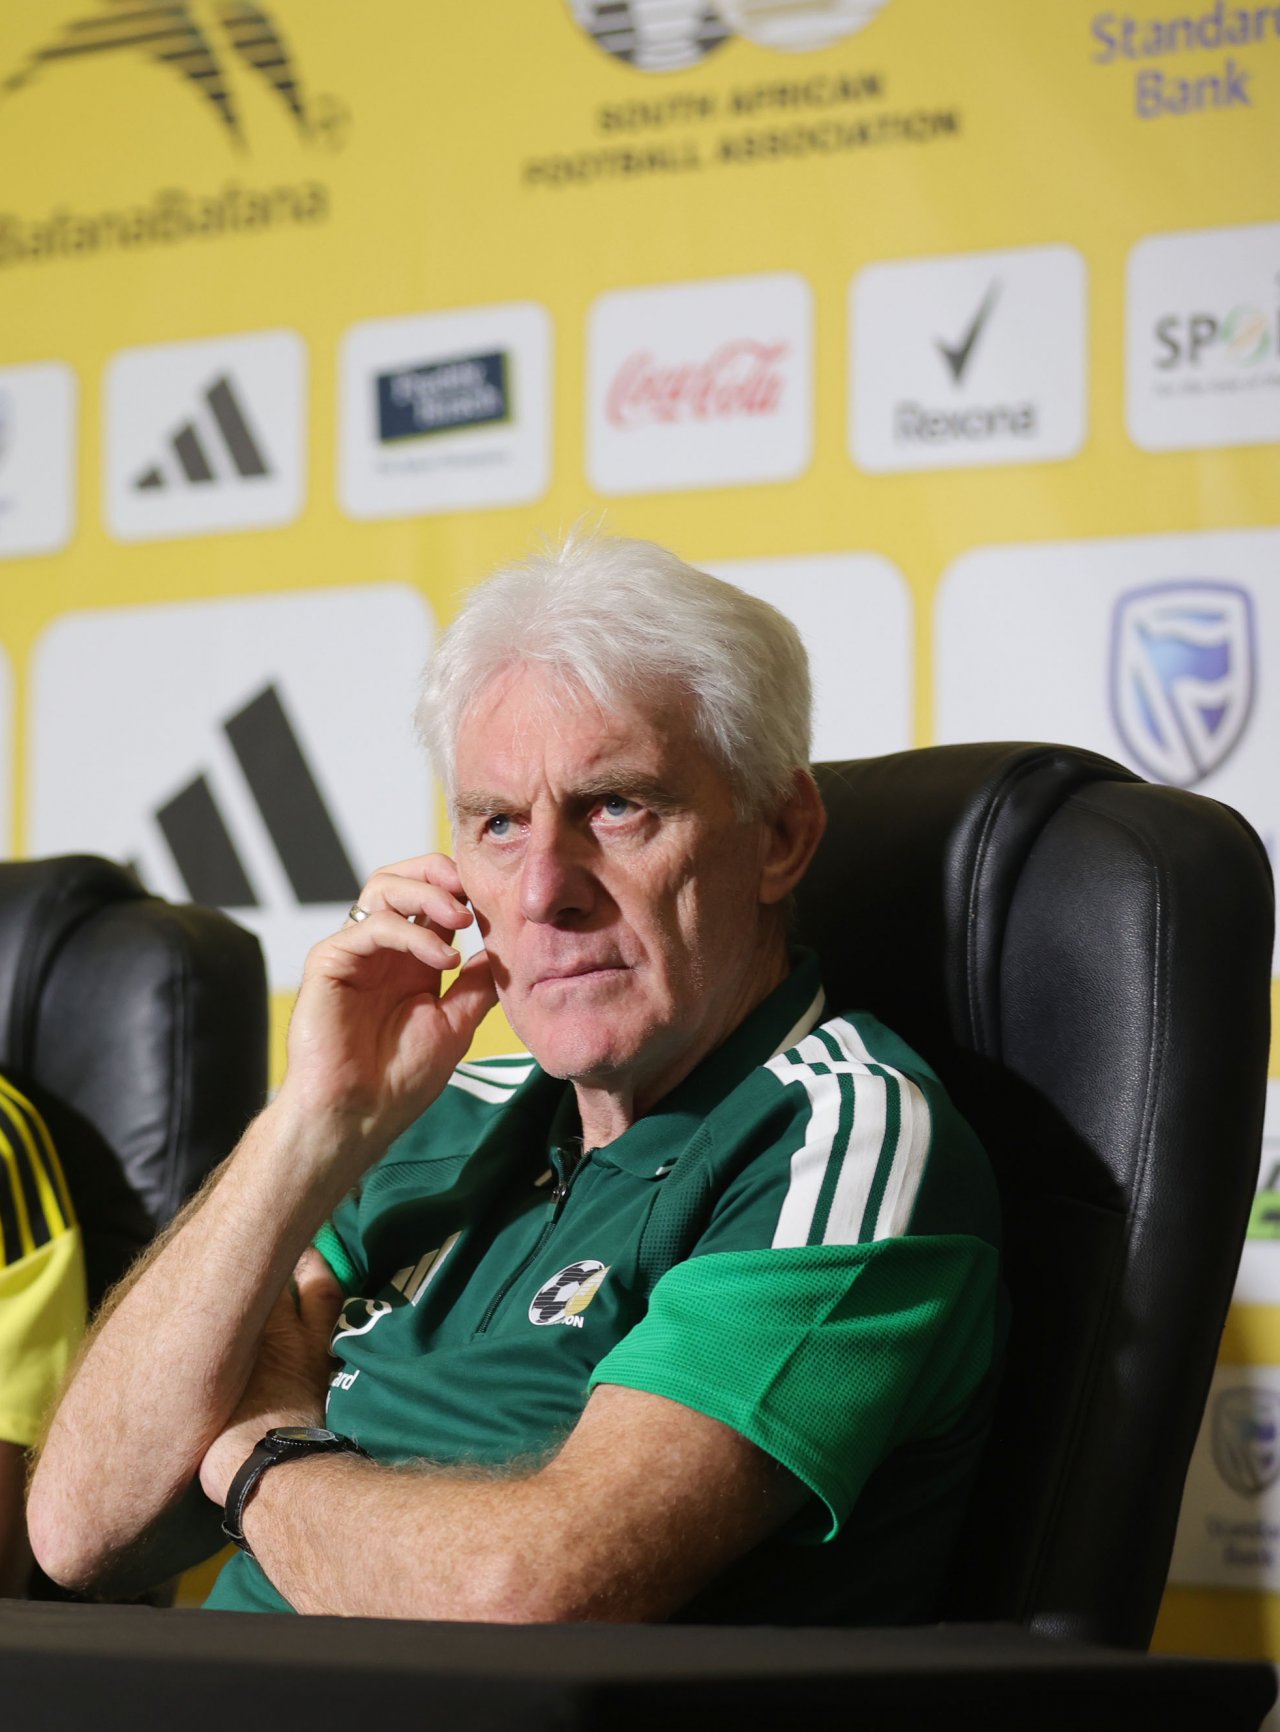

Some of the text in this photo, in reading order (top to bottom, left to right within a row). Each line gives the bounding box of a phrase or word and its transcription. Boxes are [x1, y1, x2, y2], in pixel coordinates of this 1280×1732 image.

[600, 74, 883, 135] SOUTH AFRICAN
[1136, 57, 1252, 119] Bank
[524, 108, 962, 188] FOOTBALL ASSOCIATION
[894, 401, 1037, 445] Rexona
